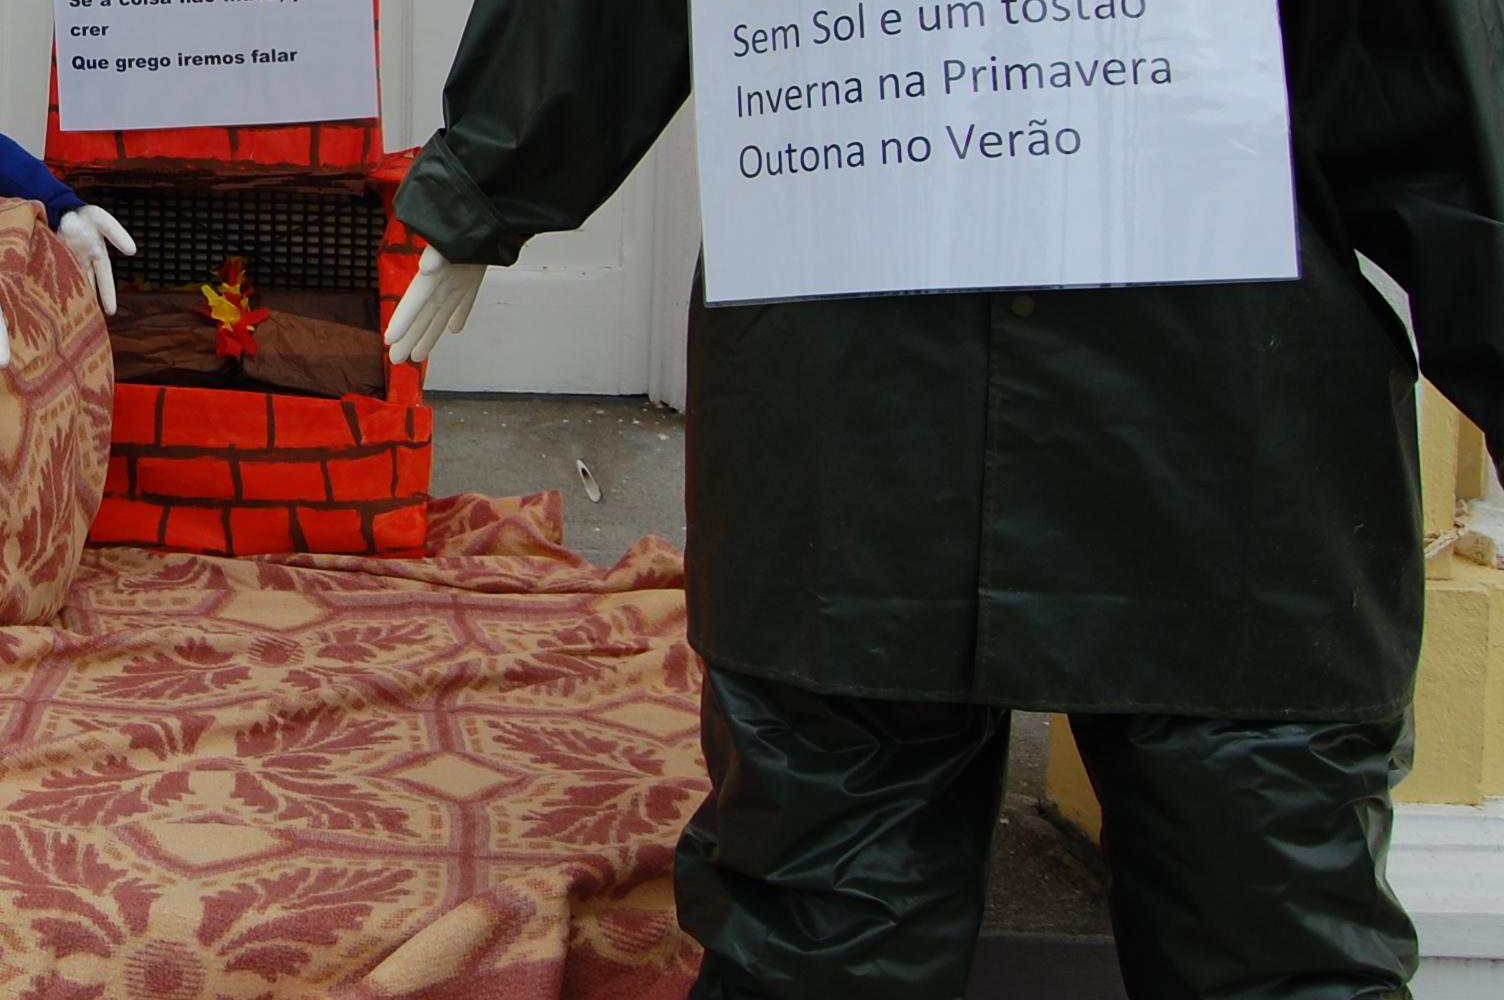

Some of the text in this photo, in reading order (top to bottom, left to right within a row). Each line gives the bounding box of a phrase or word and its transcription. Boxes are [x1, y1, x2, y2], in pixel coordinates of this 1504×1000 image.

[70, 25, 110, 37] crer
[733, 23, 801, 58] Sem
[812, 1, 865, 45] Sol
[880, 8, 903, 36] e
[918, 0, 985, 32] um
[71, 48, 298, 73] Que grego iremos falar
[736, 55, 1172, 119] Inverna na Primavera
[739, 118, 1081, 179] Outona no Verão
